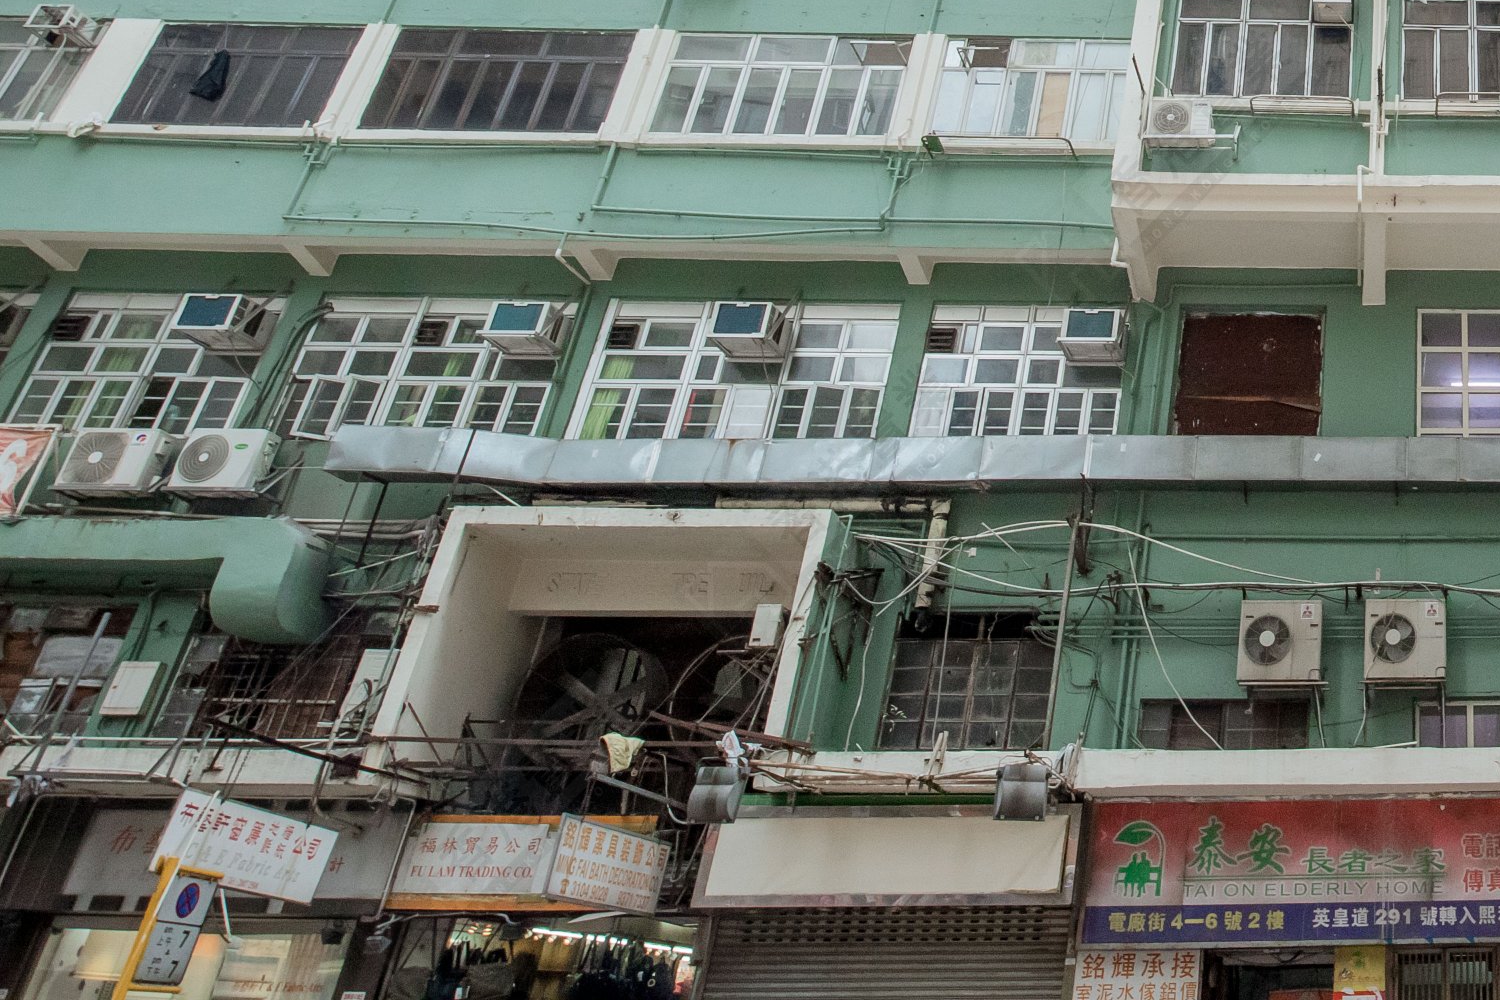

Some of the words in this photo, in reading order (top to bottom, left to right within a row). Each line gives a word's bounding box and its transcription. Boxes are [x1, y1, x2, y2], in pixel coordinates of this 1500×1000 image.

[420, 835, 543, 855] 福林貿易公司
[410, 865, 425, 878] FU
[428, 865, 457, 878] LAM
[458, 865, 511, 879] TRADING
[513, 865, 534, 879] CO.
[555, 853, 577, 876] MING
[588, 861, 609, 884] BATH
[1184, 882, 1216, 898] TAI
[1224, 882, 1256, 897] ON
[1266, 881, 1369, 897] ELDERLY
[1377, 880, 1444, 895] HOME
[1081, 952, 1197, 980] 銘輝承接
